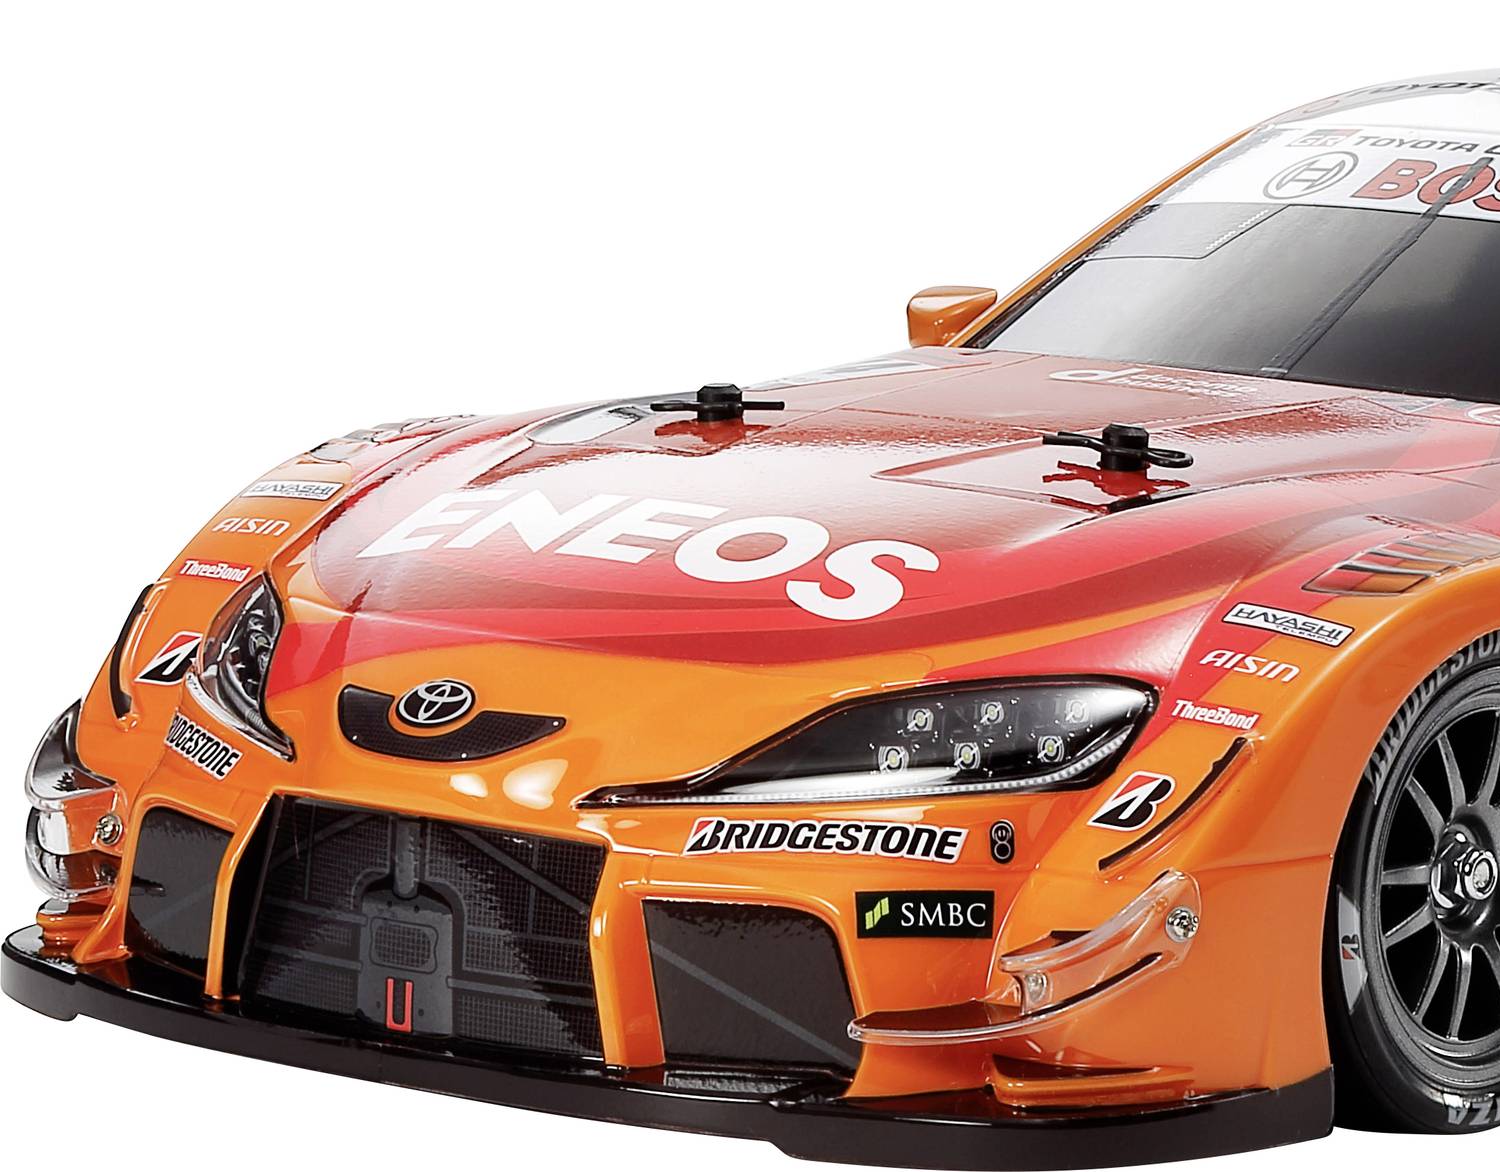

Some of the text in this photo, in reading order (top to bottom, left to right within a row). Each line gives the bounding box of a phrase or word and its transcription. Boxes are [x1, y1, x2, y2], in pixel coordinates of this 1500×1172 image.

[1353, 135, 1480, 152] TOYOTA
[250, 483, 335, 496] HAYASHI
[211, 517, 291, 537] AISIN
[356, 488, 941, 621] ENEOS
[179, 559, 251, 583] ThreeBond
[1231, 607, 1344, 641] HAYASHI
[1200, 649, 1301, 683] AISIN
[1171, 699, 1260, 729] ThreeBond
[686, 818, 966, 862] BRIDGESTONE
[900, 899, 987, 929] SMBC
